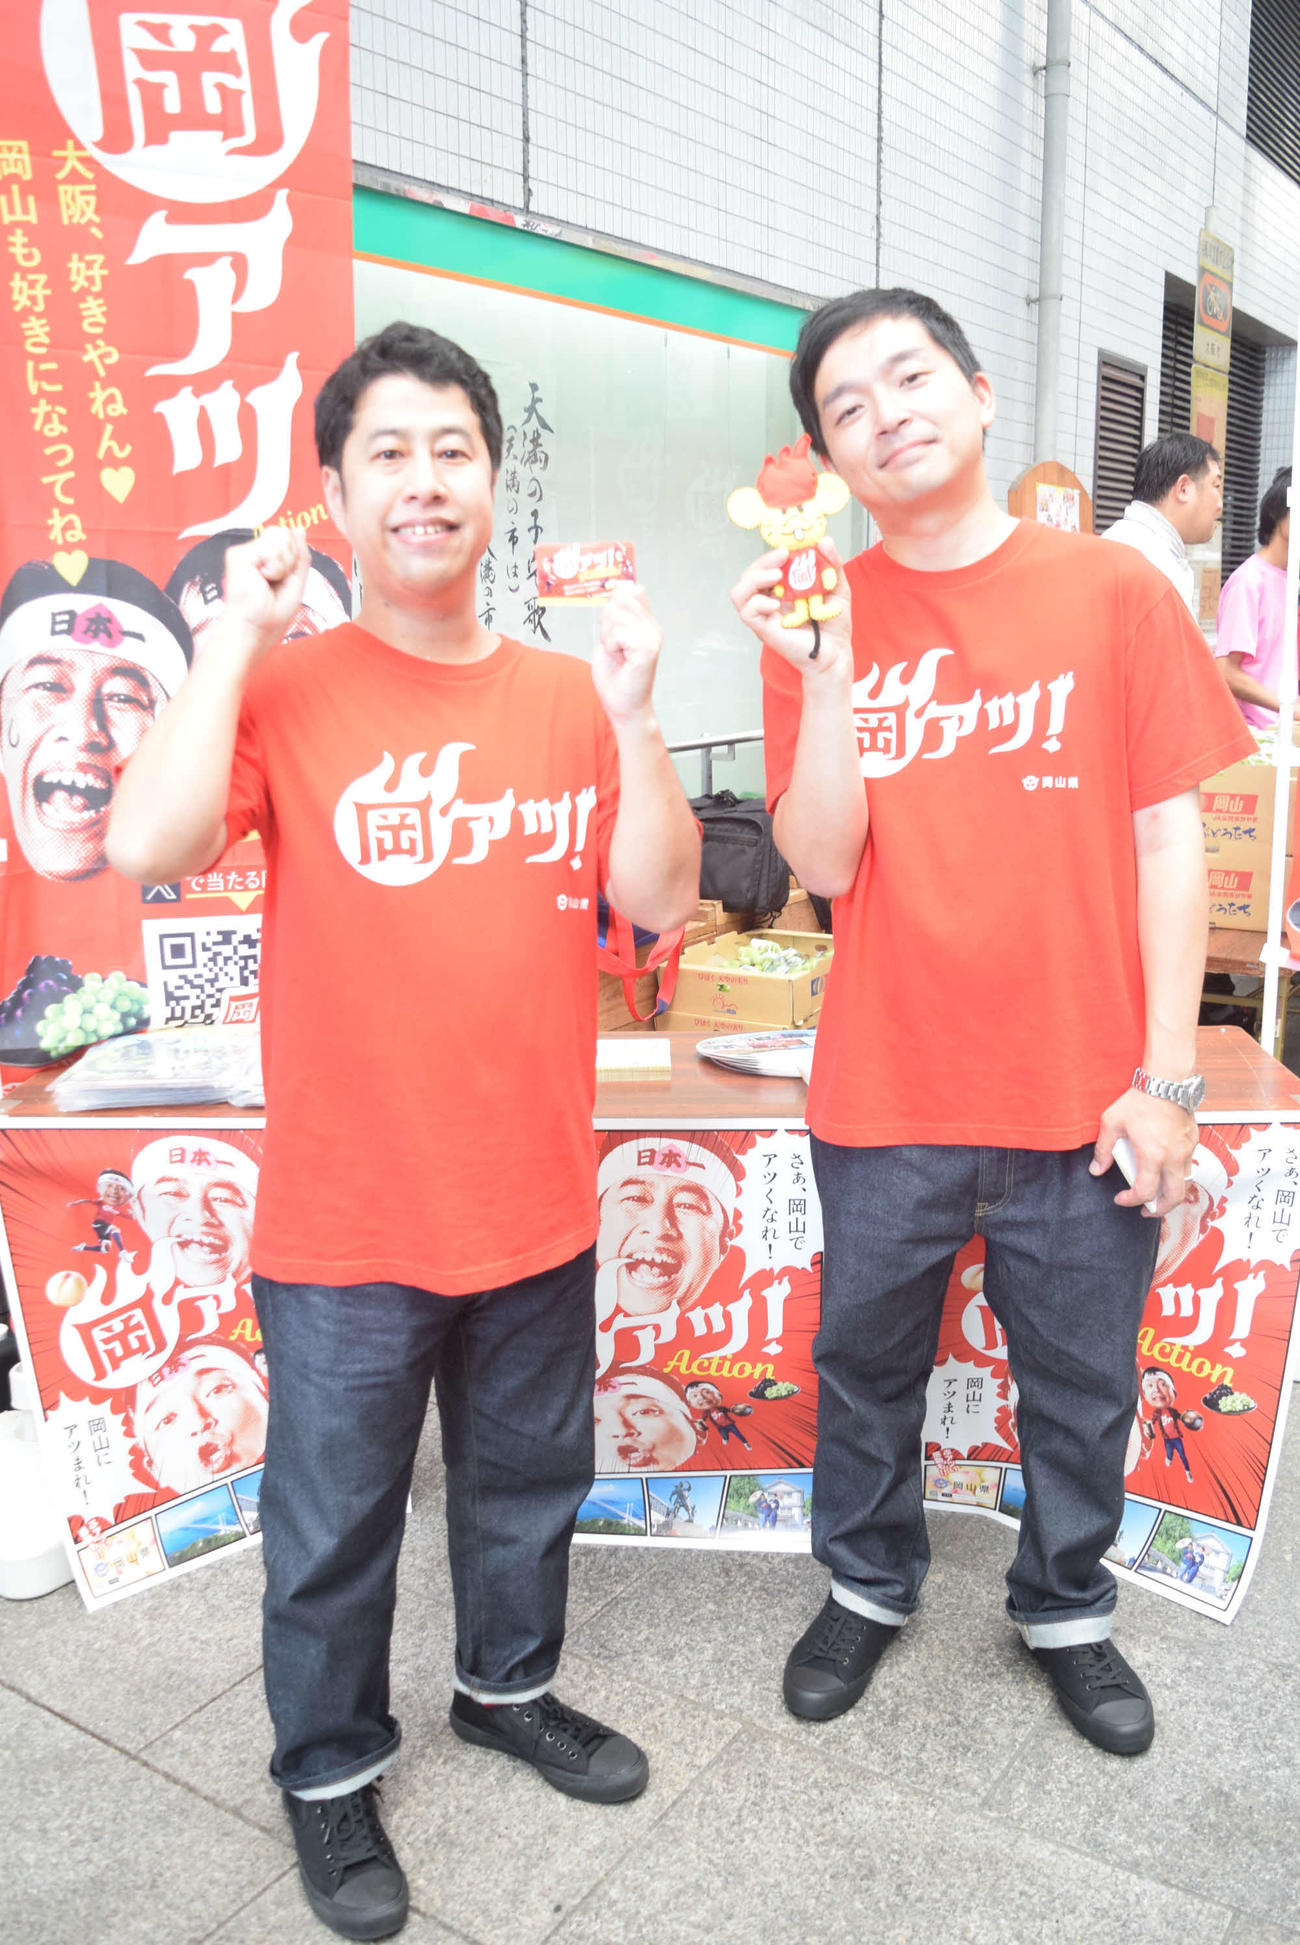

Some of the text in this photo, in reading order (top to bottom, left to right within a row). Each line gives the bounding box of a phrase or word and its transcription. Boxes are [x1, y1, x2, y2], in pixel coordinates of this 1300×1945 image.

[0, 139, 87, 547] 岡山も好きになってね
[253, 503, 328, 540] tion
[478, 546, 498, 631] 満の市
[49, 604, 146, 646] 日本一
[1212, 794, 1244, 812] 岡山
[186, 870, 266, 892] で当たる
[1208, 871, 1240, 888] 岡山
[168, 1147, 237, 1169] 日本一
[637, 1148, 706, 1170] 日本一
[60, 1237, 257, 1389] 岡ア
[148, 1354, 207, 1388] 日本一
[662, 1350, 776, 1380] Action
[1138, 1327, 1234, 1387] Action
[596, 1378, 638, 1392] 本一
[965, 1376, 984, 1415] 岡山に
[88, 1416, 112, 1467] 岡山に
